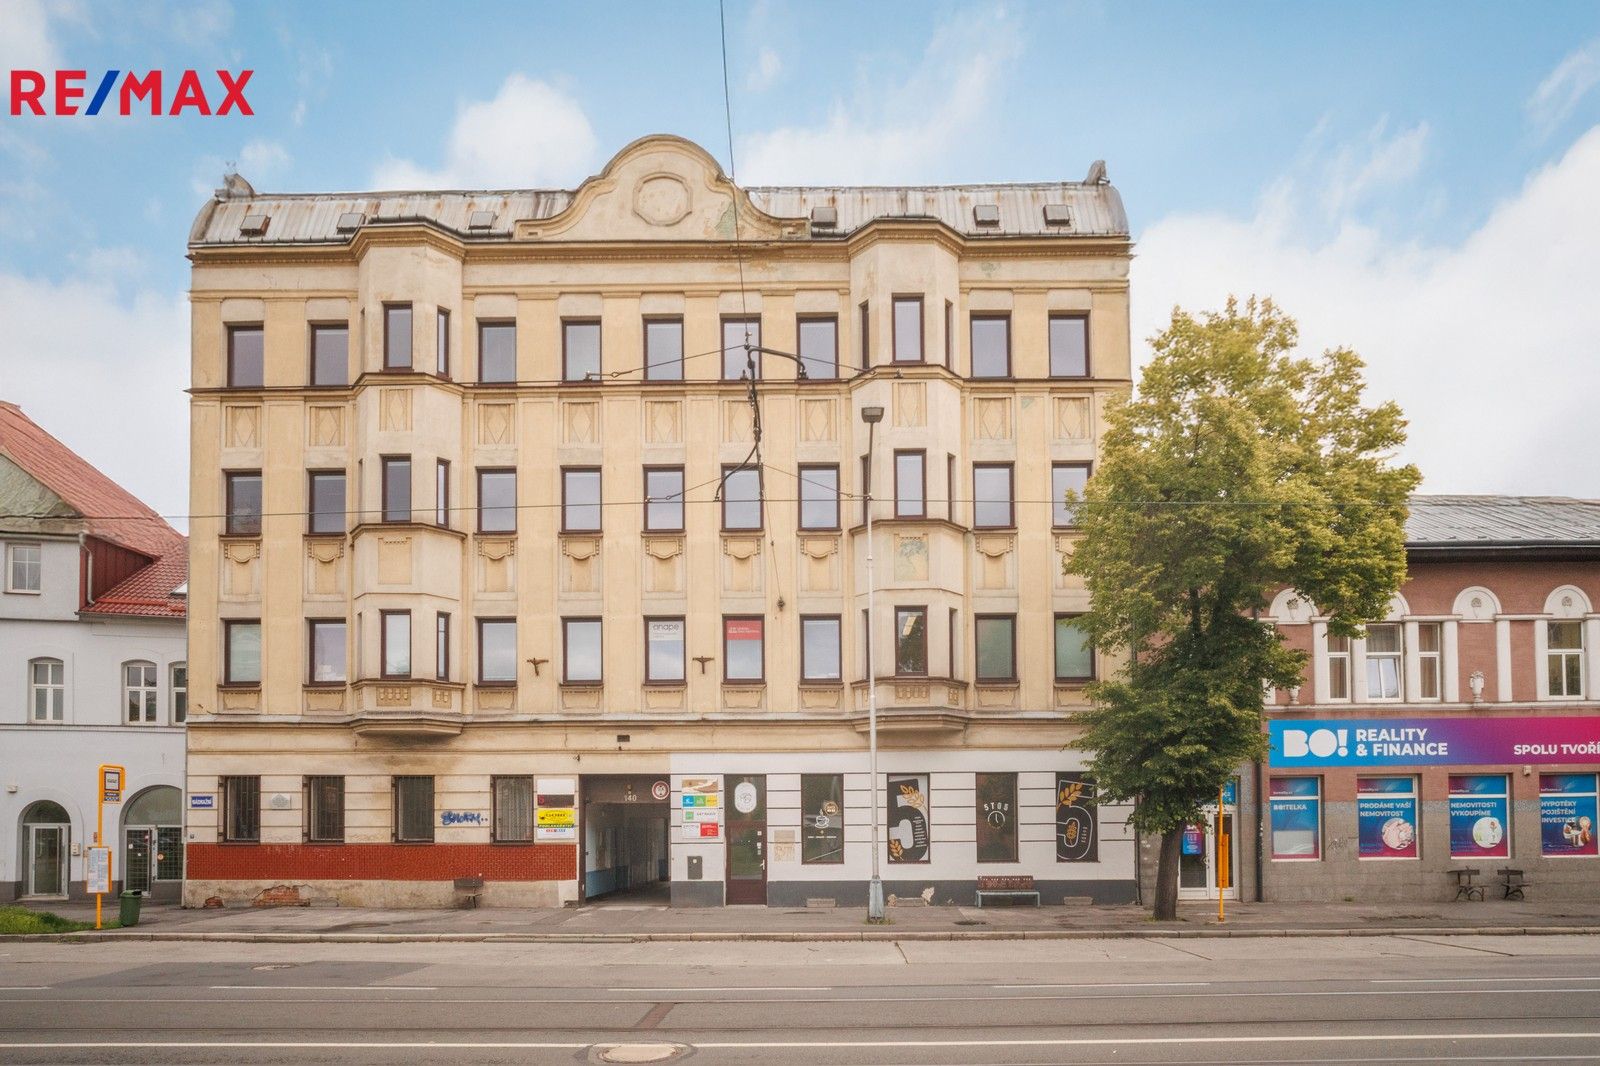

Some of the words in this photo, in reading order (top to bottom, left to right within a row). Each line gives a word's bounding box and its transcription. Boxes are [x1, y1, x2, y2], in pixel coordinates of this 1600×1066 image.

[1356, 728, 1428, 742] REALITY
[1283, 729, 1348, 757] BO!
[1356, 744, 1368, 757] &
[1373, 743, 1448, 756] FINANCE
[1513, 744, 1558, 755] SPOLU
